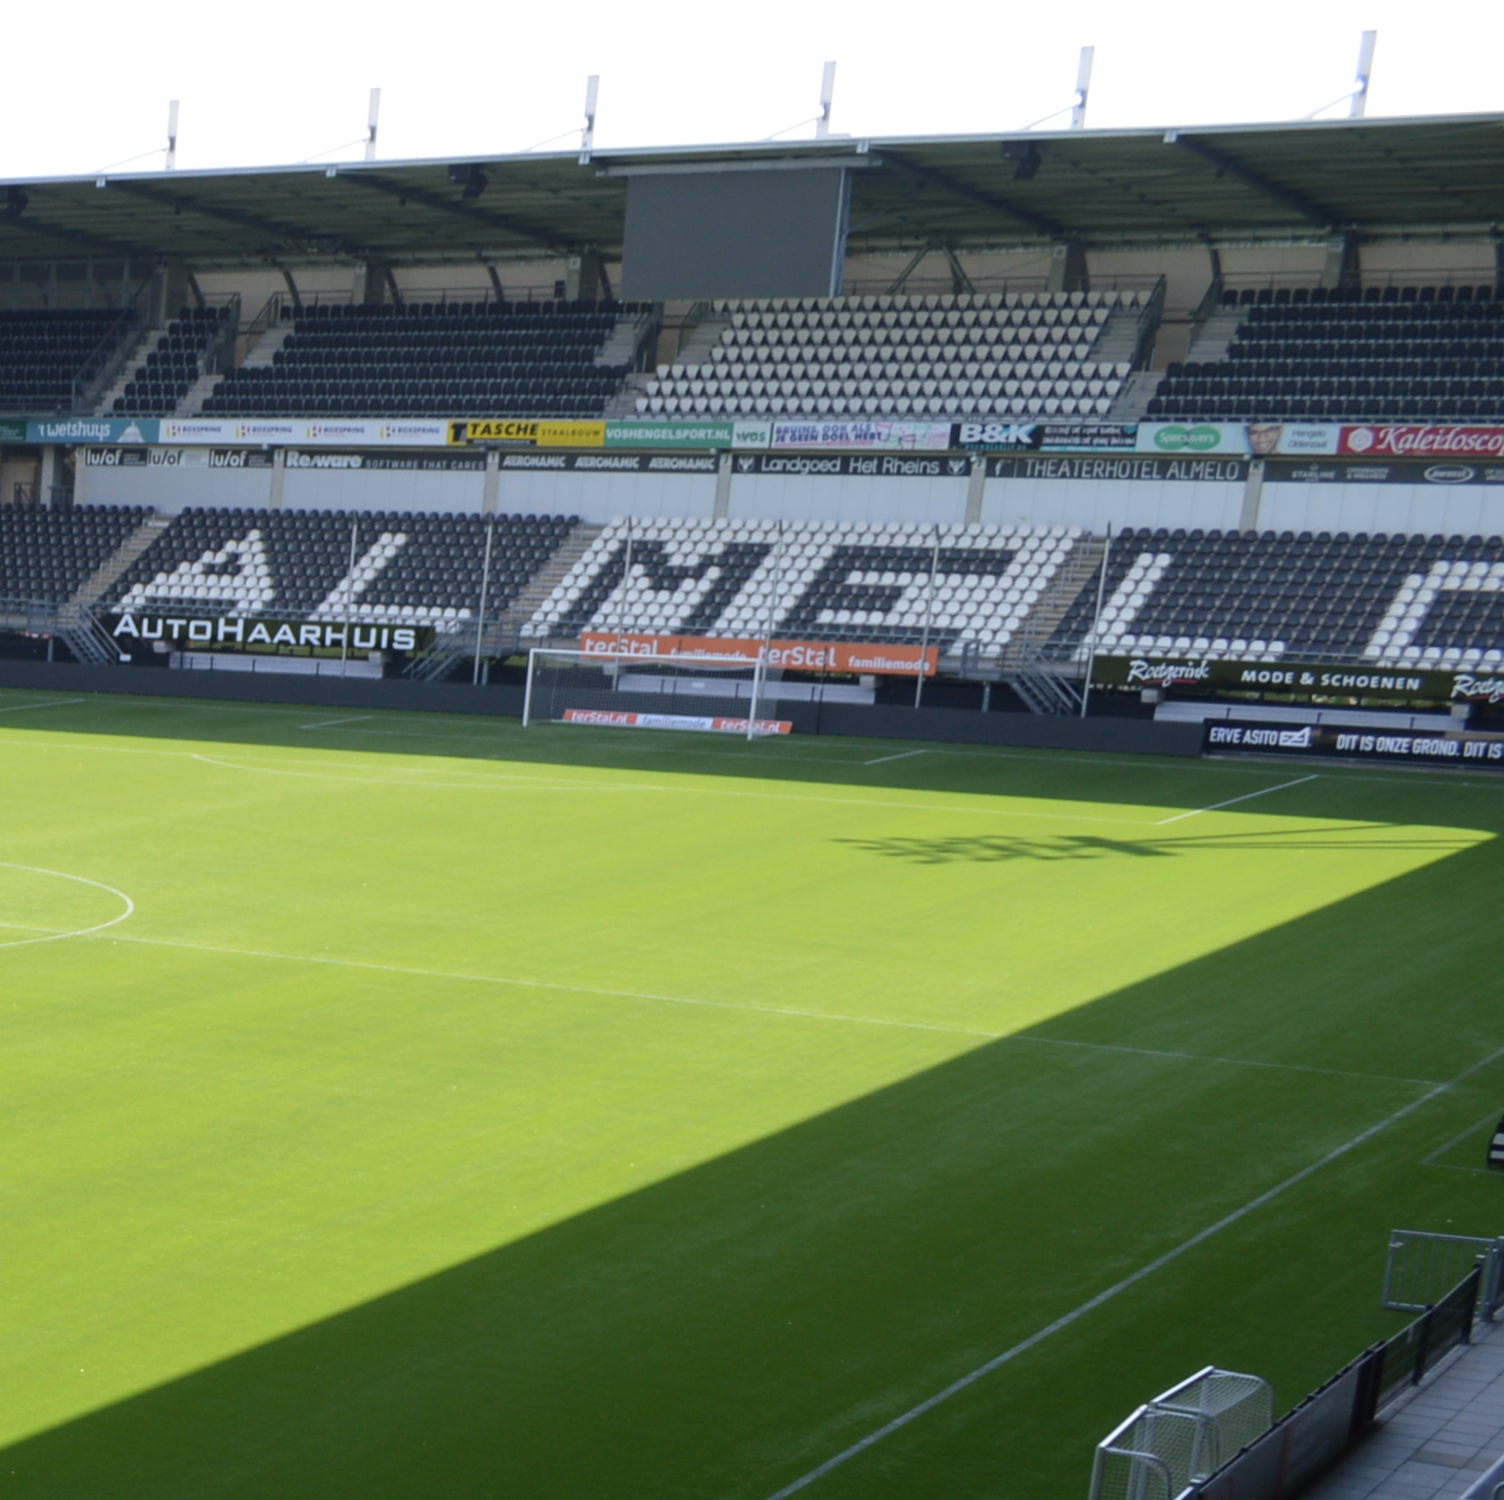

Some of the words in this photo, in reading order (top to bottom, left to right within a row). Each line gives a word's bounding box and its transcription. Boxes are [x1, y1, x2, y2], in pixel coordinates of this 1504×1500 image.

[470, 422, 538, 436] TASCHE
[605, 427, 731, 441] VOSHENGELSPORT.NL
[959, 423, 1033, 444] B&K
[1159, 431, 1215, 445] Specsavers
[366, 459, 418, 469] SOFTWARE
[422, 460, 447, 469] THAT
[452, 461, 484, 471] CARES
[502, 455, 567, 469] AERONAMIC
[574, 456, 641, 469] AERONAMIC
[648, 457, 715, 470] AERONAMIC
[760, 456, 841, 474] Landgoed
[848, 457, 878, 474] Het
[882, 458, 940, 475] Rheins
[1024, 457, 1162, 479] THEATERHOTEL
[1165, 459, 1240, 480] ALMELO
[1240, 669, 1295, 684] MODE
[1300, 672, 1315, 685] &
[1319, 672, 1422, 691] SCHOENEN
[570, 710, 628, 725] terStal.nl
[1209, 726, 1242, 744] ERVE
[1243, 728, 1279, 746] ASITO
[1336, 733, 1358, 751] DIT
[1360, 735, 1375, 752] IS
[1376, 736, 1411, 754] ONZE
[1412, 737, 1460, 757] GROND.
[1464, 740, 1488, 758] DIT
